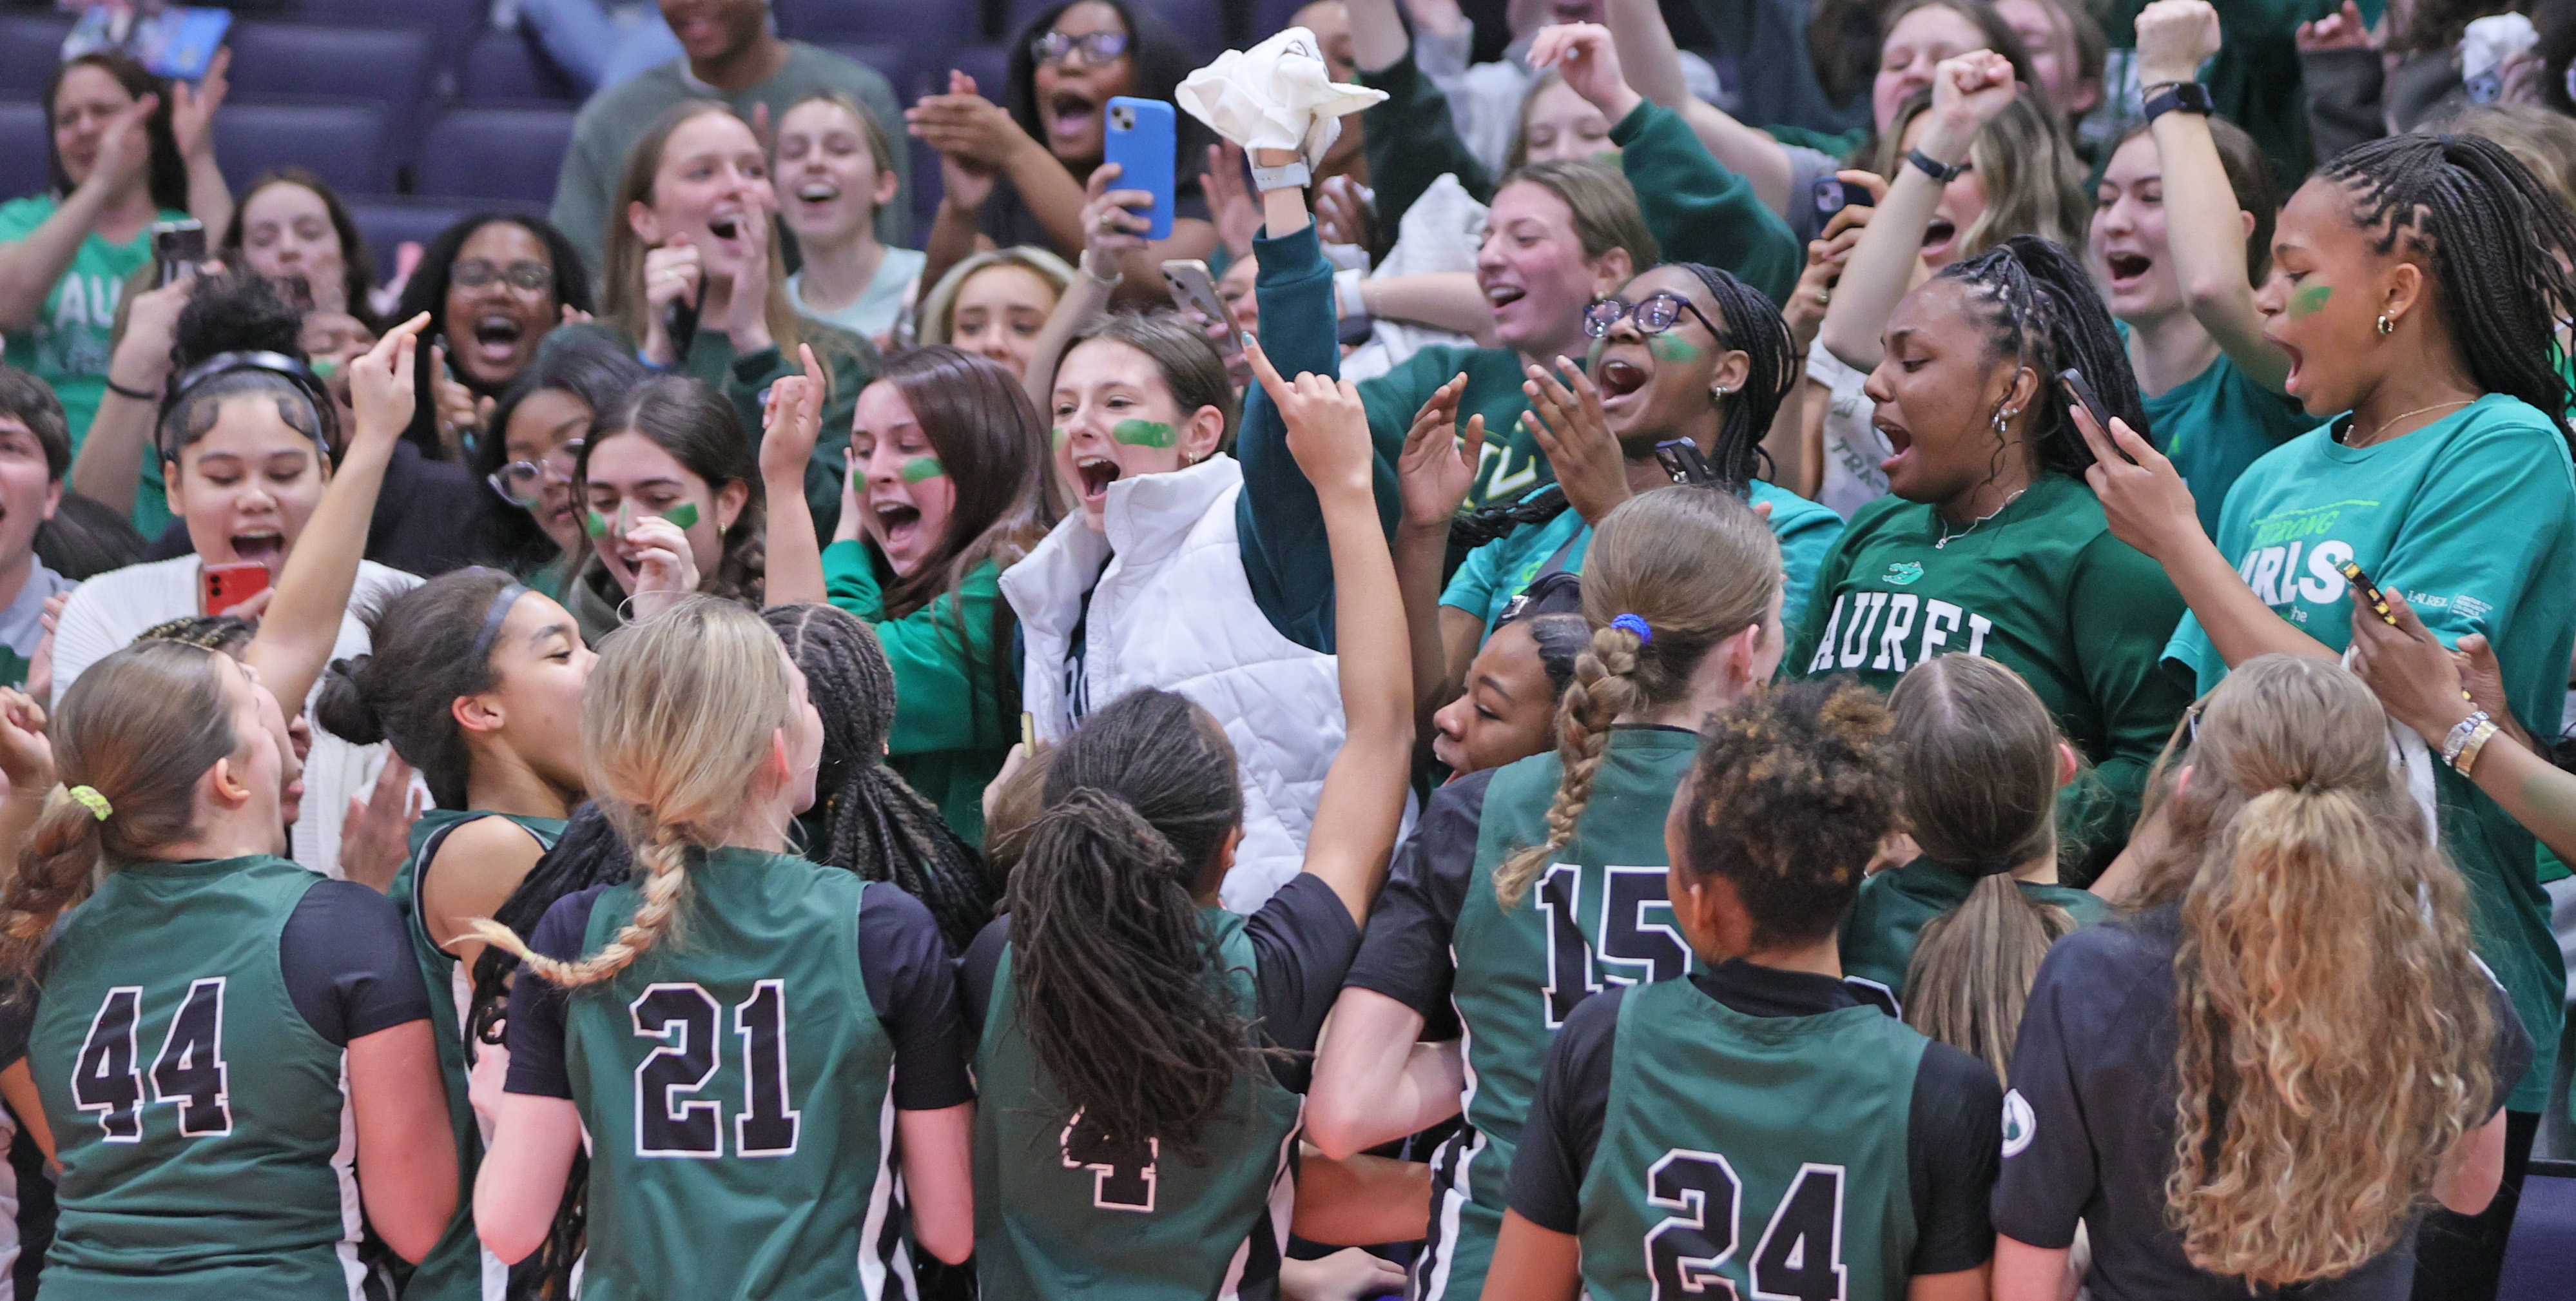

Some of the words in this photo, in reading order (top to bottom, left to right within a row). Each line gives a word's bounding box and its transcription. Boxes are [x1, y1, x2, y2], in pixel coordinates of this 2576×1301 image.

[2238, 540, 2354, 606] IRLS
[1535, 863, 1693, 1030] 15
[71, 976, 233, 1143] 44
[628, 979, 801, 1159] 21
[1644, 1148, 1848, 1301] 24
